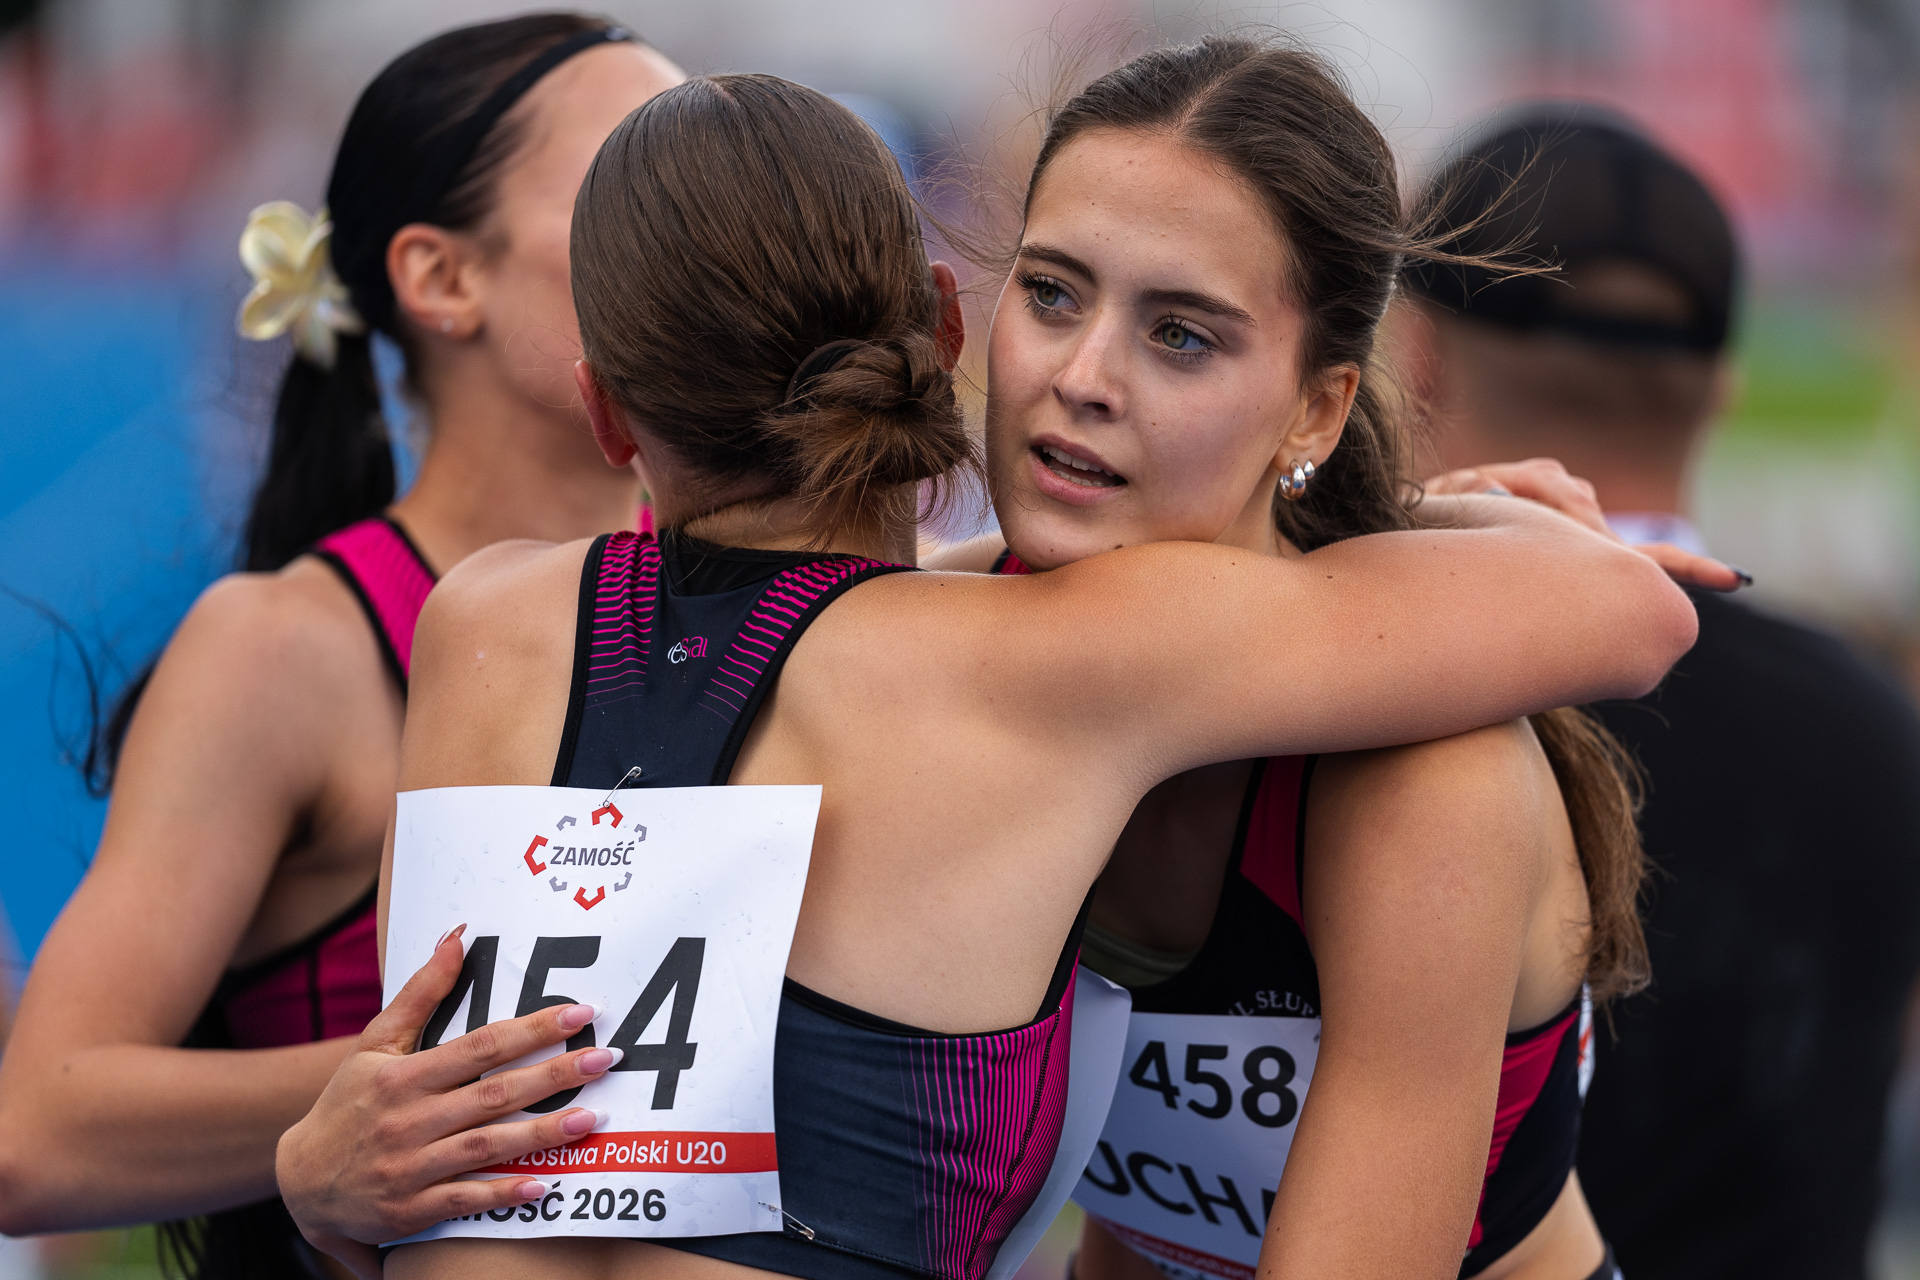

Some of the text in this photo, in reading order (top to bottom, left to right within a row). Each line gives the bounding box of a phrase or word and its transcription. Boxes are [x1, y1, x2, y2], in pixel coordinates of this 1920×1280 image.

[550, 840, 635, 866] ZAMOŚĆ
[419, 935, 706, 1115] 454
[1129, 1040, 1299, 1128] 458
[602, 1140, 669, 1165] Polski
[676, 1141, 727, 1165] U20
[570, 1188, 667, 1222] 2026
